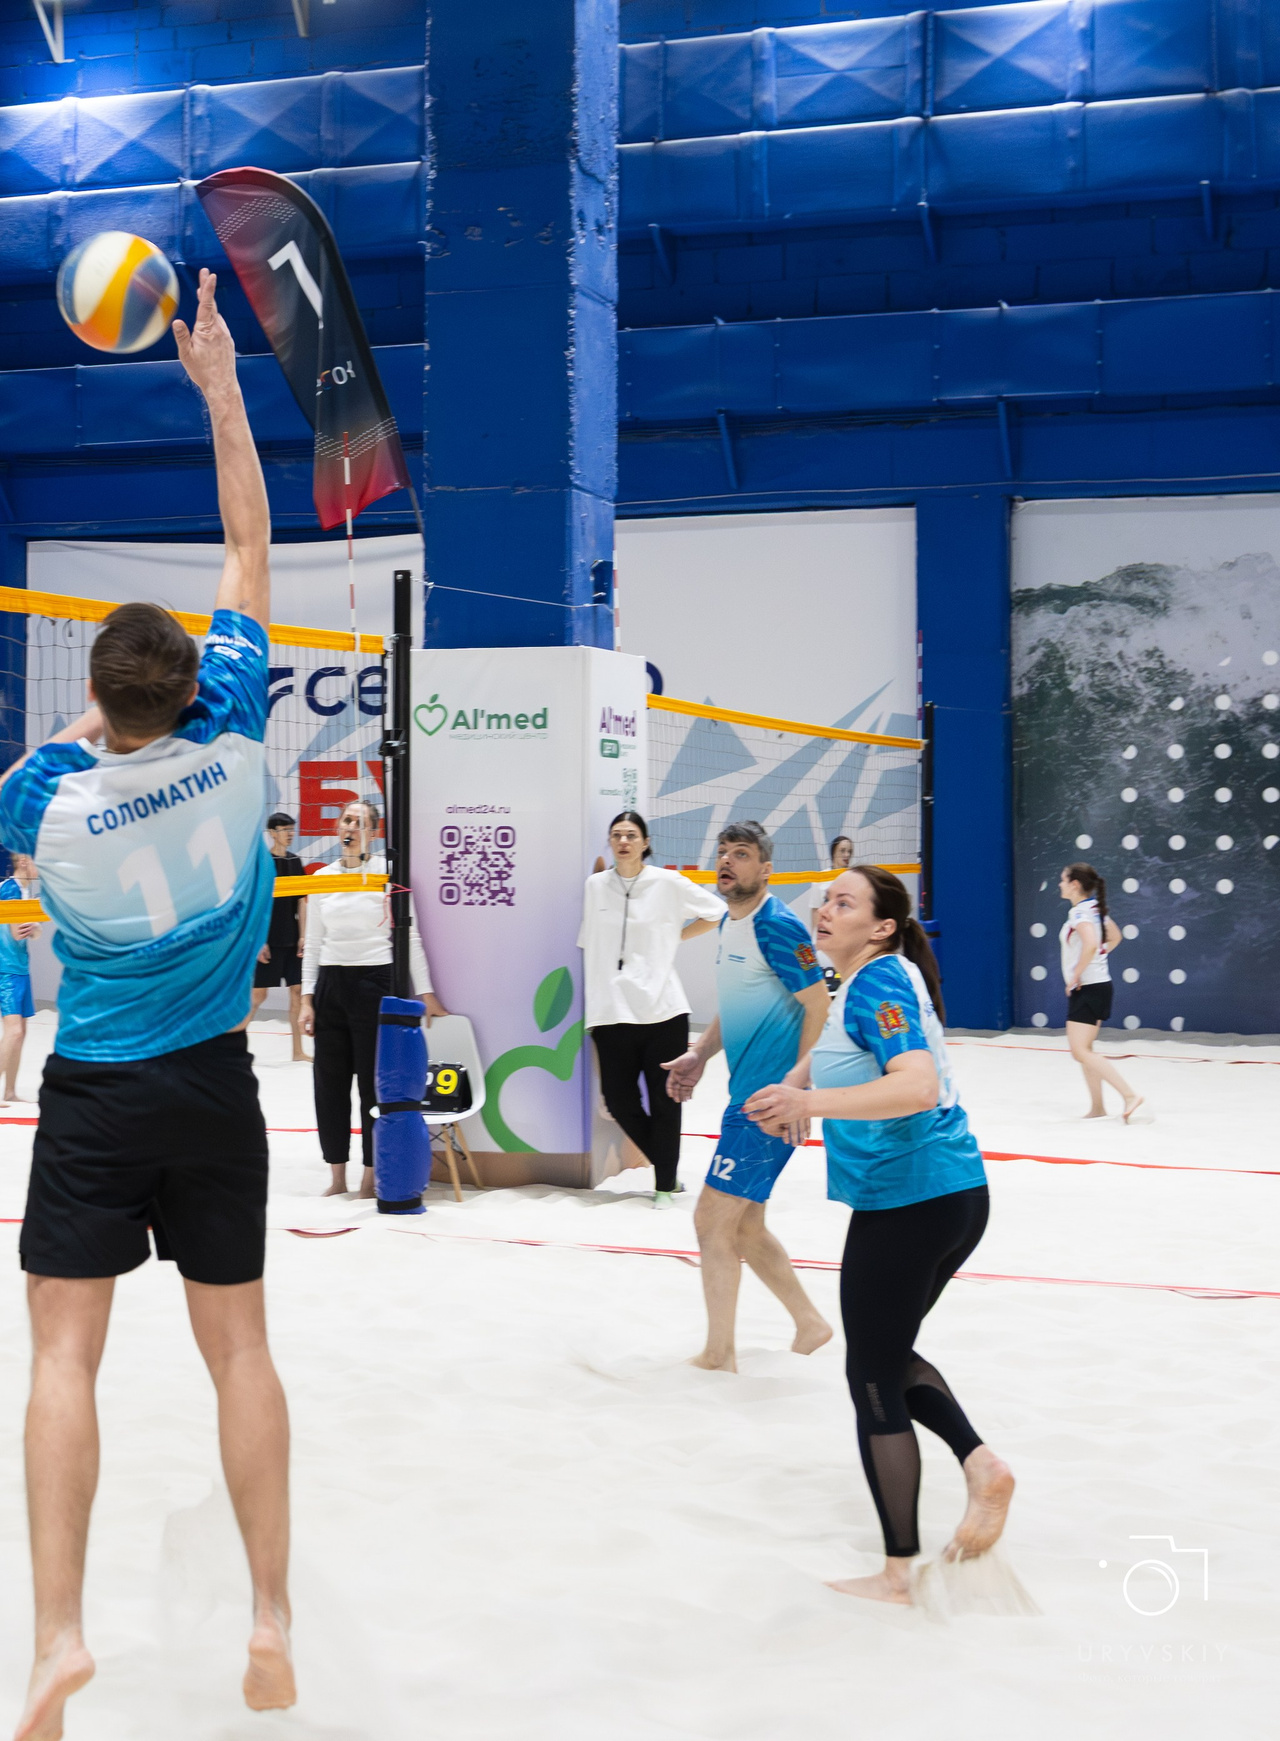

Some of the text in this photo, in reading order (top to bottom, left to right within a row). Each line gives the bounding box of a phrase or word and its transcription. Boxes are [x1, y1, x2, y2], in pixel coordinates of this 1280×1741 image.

[450, 707, 548, 730] Al'med
[87, 762, 228, 835] СОЛОМАТИН
[116, 815, 238, 937] 11
[435, 1069, 459, 1095] 9
[711, 1154, 737, 1181] 12
